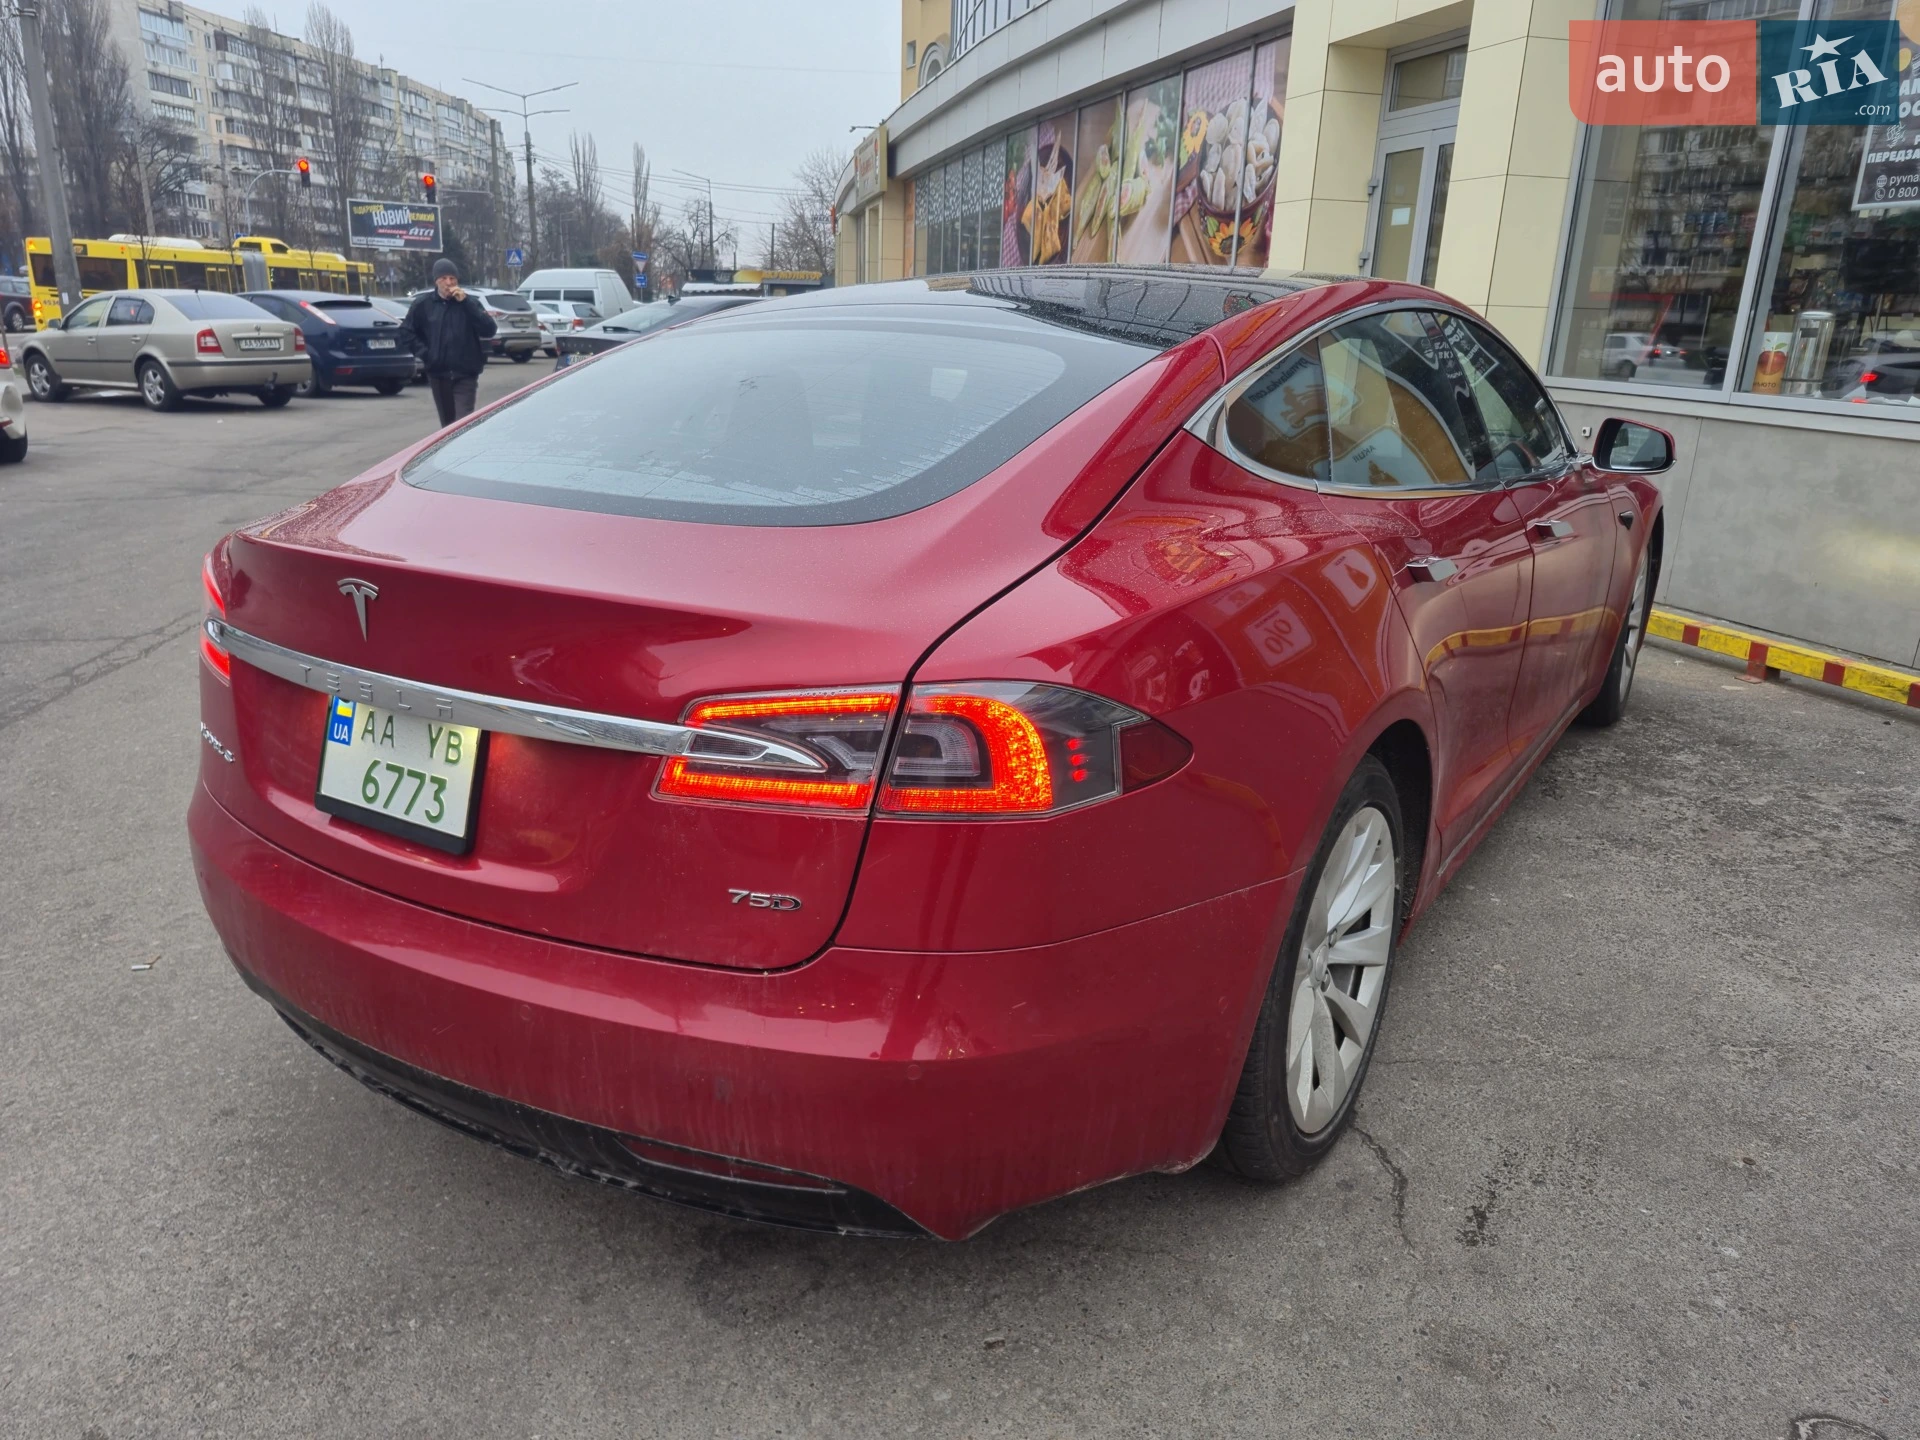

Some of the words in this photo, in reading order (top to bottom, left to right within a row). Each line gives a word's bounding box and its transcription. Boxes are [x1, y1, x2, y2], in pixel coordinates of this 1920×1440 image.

[1889, 188, 1896, 198] 0
[1898, 186, 1918, 198] 800
[372, 206, 412, 226] НОВИЙ
[299, 664, 453, 720] TESLA
[333, 722, 349, 743] UA
[361, 711, 395, 748] AA
[428, 724, 463, 765] YB
[361, 759, 449, 824] 6773
[728, 889, 802, 911] 75D
